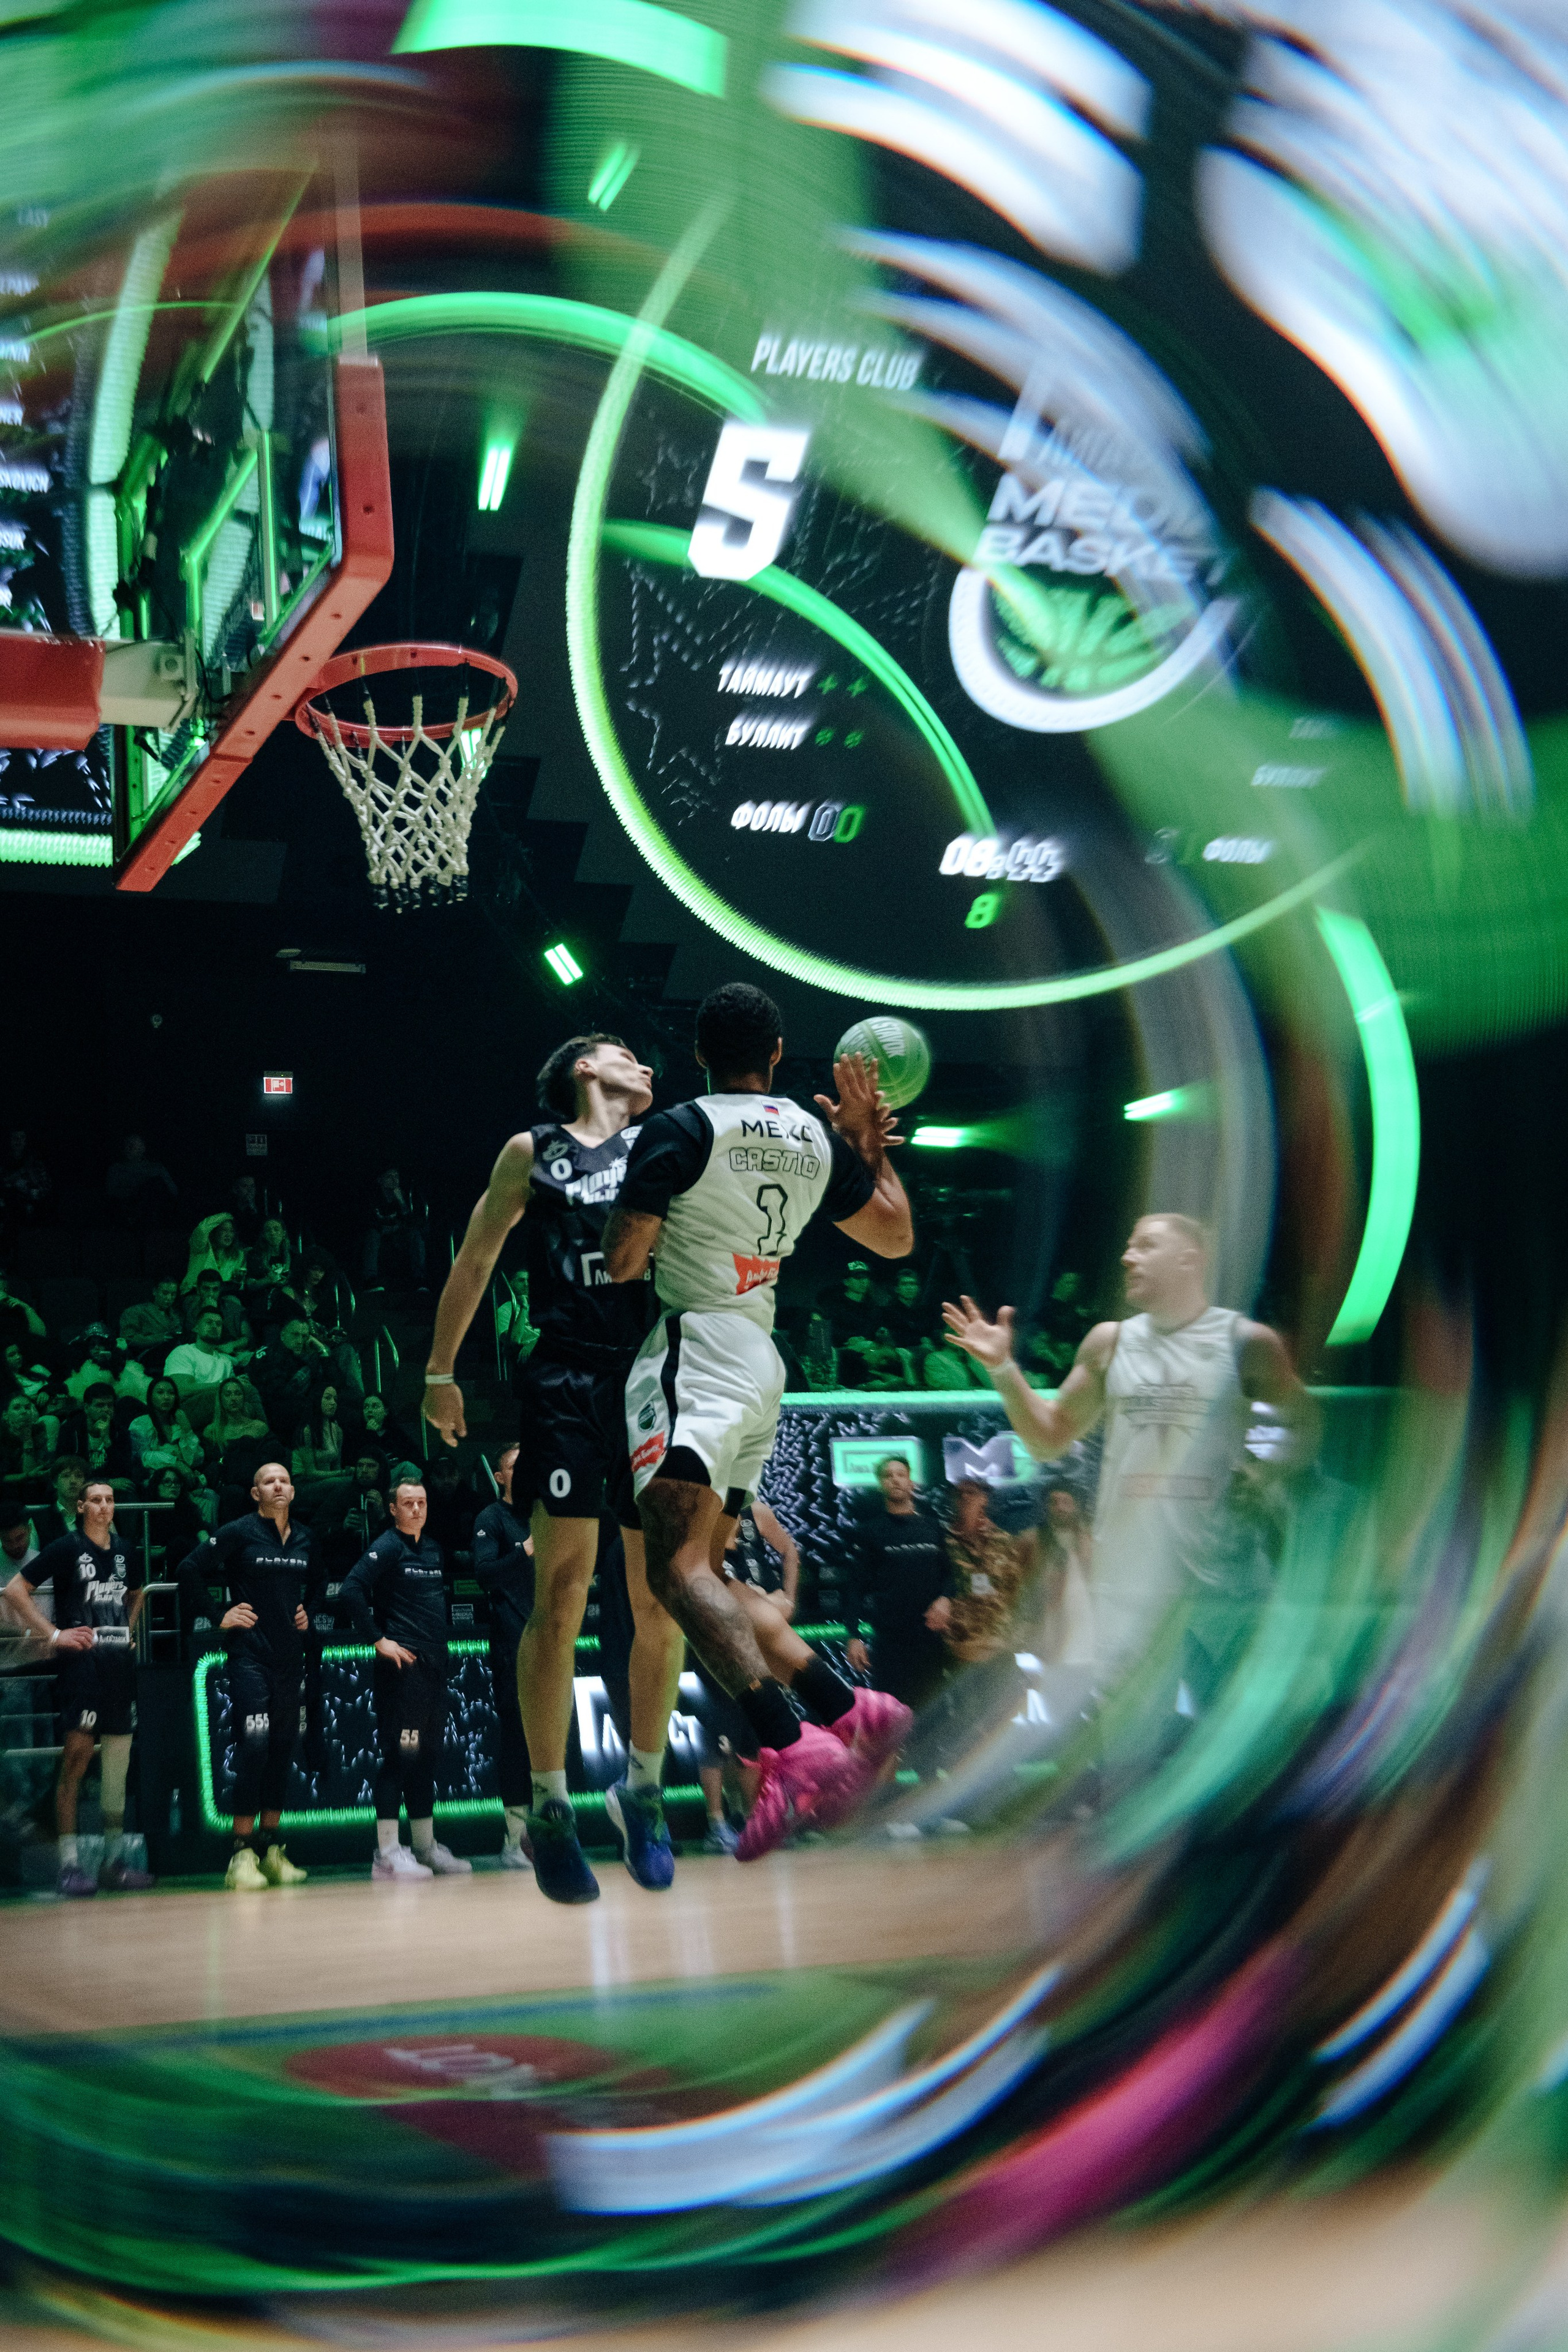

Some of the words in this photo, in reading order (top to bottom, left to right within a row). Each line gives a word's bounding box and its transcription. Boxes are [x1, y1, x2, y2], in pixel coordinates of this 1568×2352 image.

[751, 334, 856, 385] PLAYERS
[857, 348, 924, 391] CLUB
[717, 663, 817, 699] ТАЙМАУТ
[725, 717, 813, 751] БУЛЛИТ
[731, 800, 810, 834] ФОЛЫ
[964, 894, 1002, 929] 8
[729, 1147, 821, 1180] CASTO
[549, 1468, 571, 1499] 0
[79, 1563, 97, 1580] 10
[80, 1709, 97, 1727] 10
[400, 1729, 419, 1746] 55
